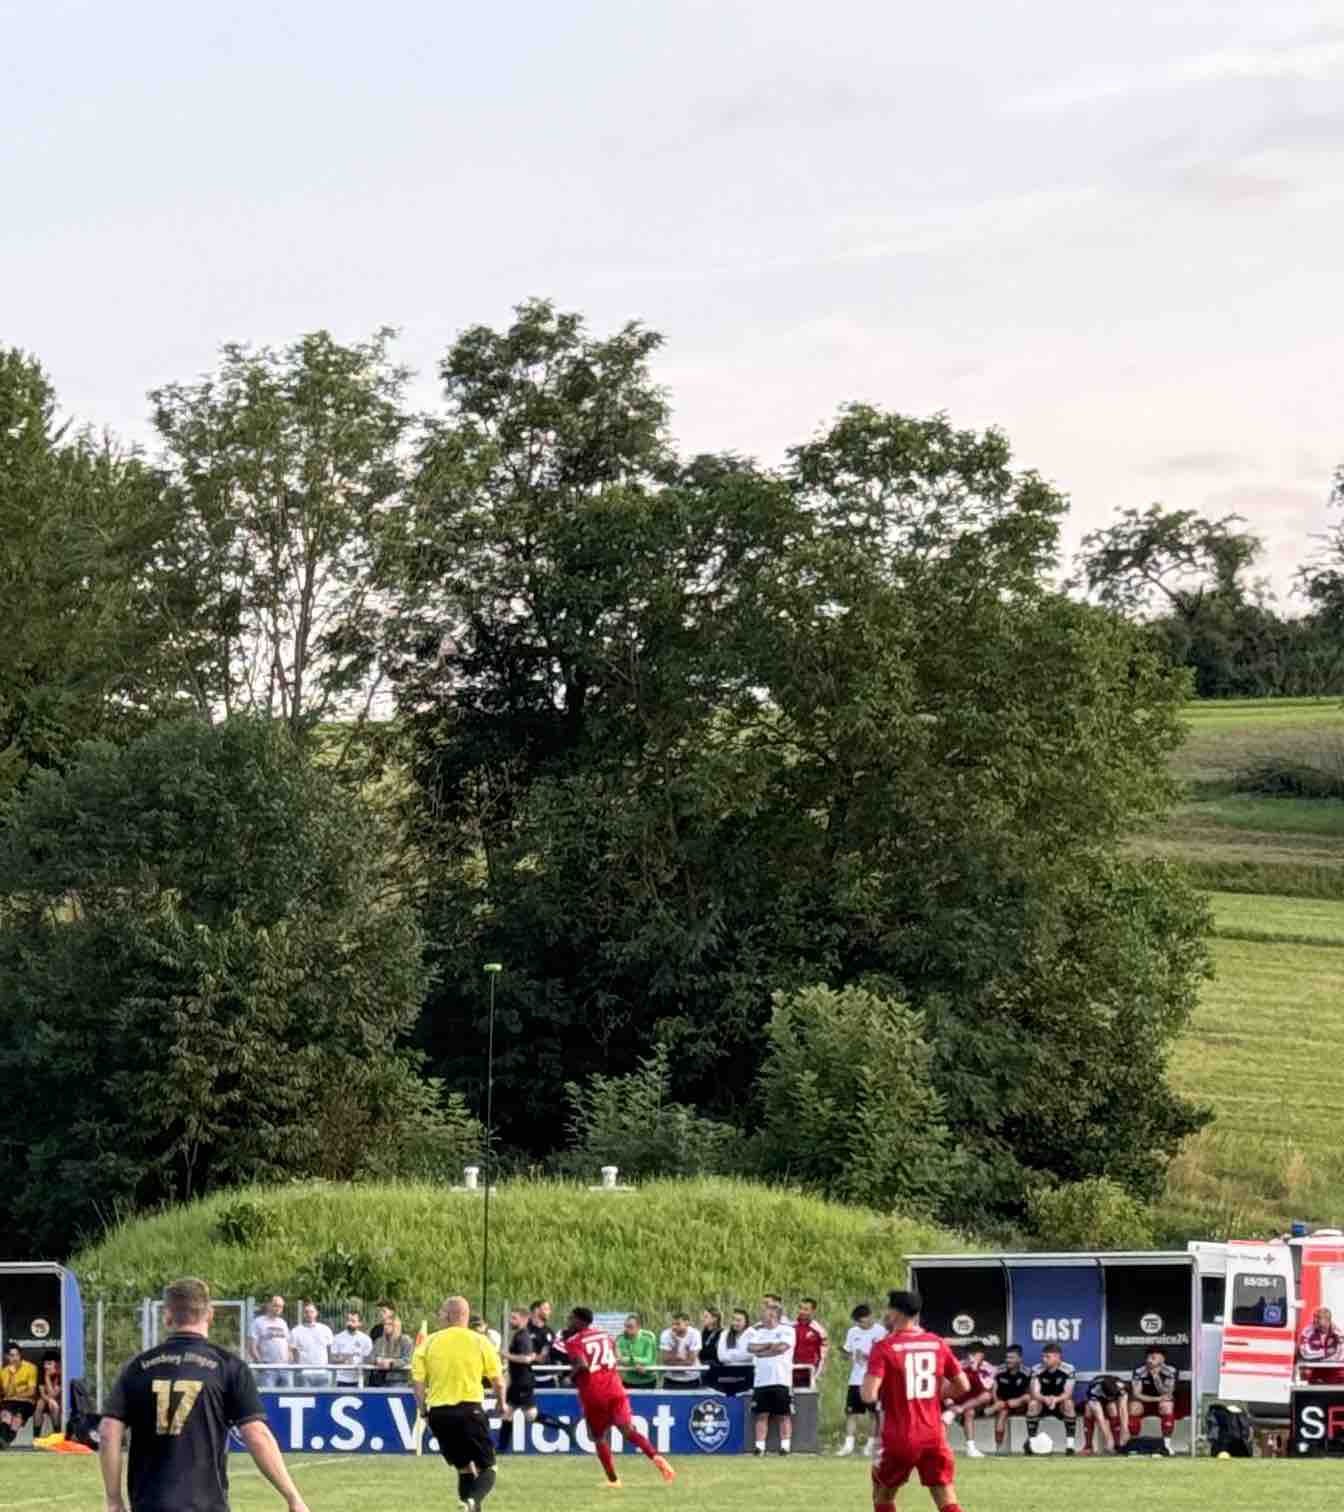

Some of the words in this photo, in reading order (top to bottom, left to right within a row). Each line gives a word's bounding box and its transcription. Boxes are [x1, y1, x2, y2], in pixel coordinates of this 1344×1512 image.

[1031, 1318, 1083, 1342] GAST
[585, 1339, 617, 1373] 24
[904, 1351, 938, 1400] 18
[151, 1379, 204, 1436] 17
